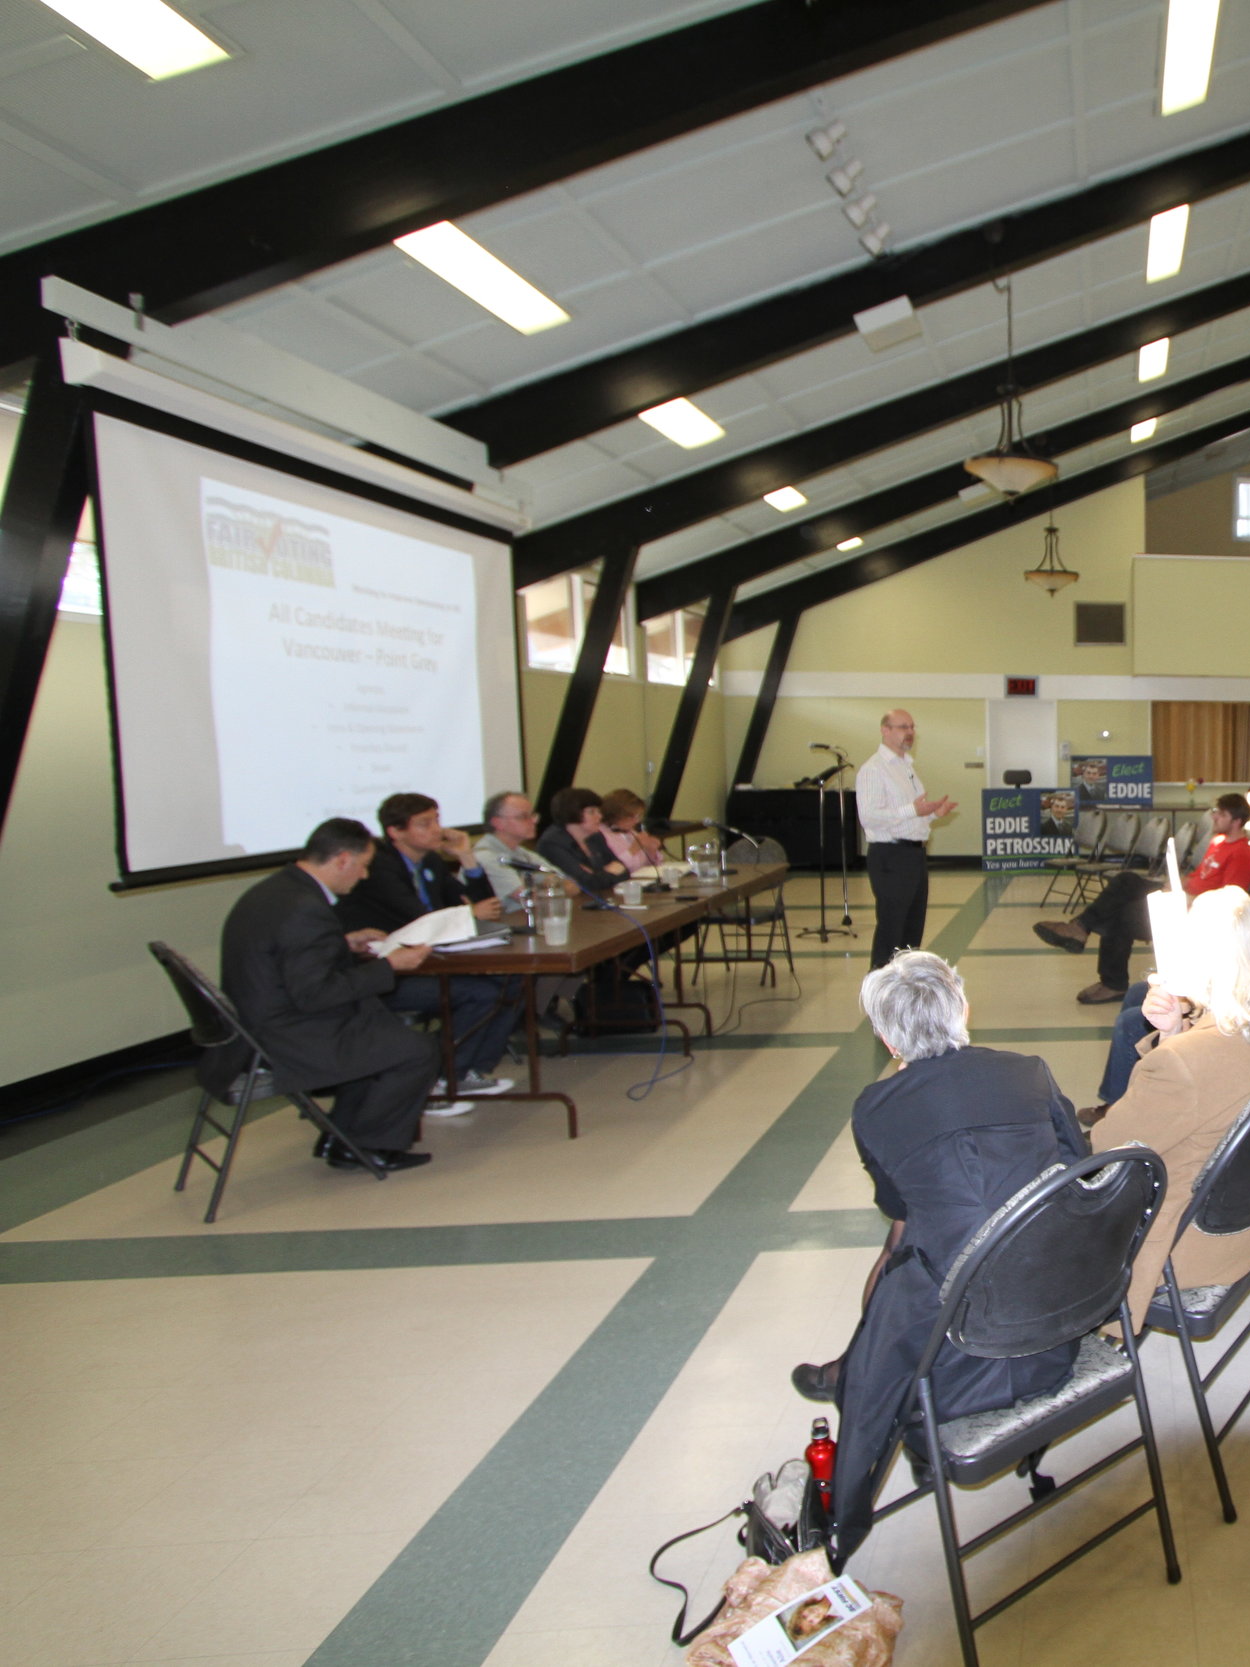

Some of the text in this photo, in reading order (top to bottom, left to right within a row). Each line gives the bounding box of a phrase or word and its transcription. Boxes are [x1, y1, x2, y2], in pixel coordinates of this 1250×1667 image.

[268, 602, 444, 648] All Candidates Meeting for
[282, 636, 363, 666] Vancouver
[375, 647, 409, 670] Point
[411, 653, 439, 674] Grey
[1111, 762, 1145, 778] Elect
[1108, 783, 1152, 798] EDDIE
[989, 794, 1023, 812] Elect
[986, 816, 1030, 834] EDDIE
[986, 837, 1075, 855] PETROSSIAN
[986, 860, 1000, 870] Yes
[1001, 861, 1017, 871] you
[1019, 858, 1038, 868] have
